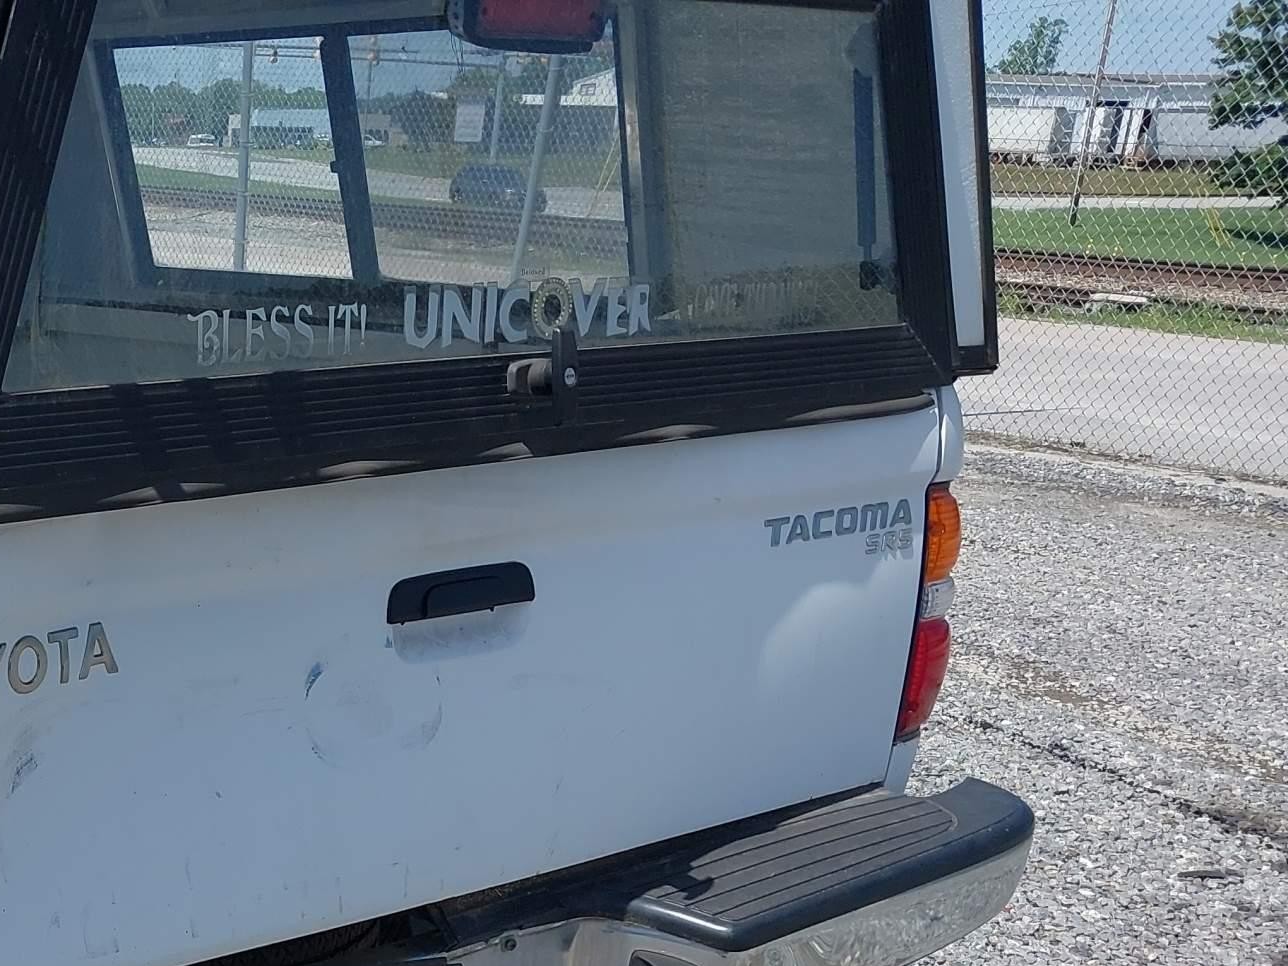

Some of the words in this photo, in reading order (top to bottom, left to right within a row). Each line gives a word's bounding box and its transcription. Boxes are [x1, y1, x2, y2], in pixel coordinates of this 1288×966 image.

[187, 304, 314, 366] BLESS
[328, 302, 367, 356] IT!
[404, 277, 652, 349] UNICOVER
[764, 499, 912, 547] TACOMA
[865, 528, 914, 556] SR5
